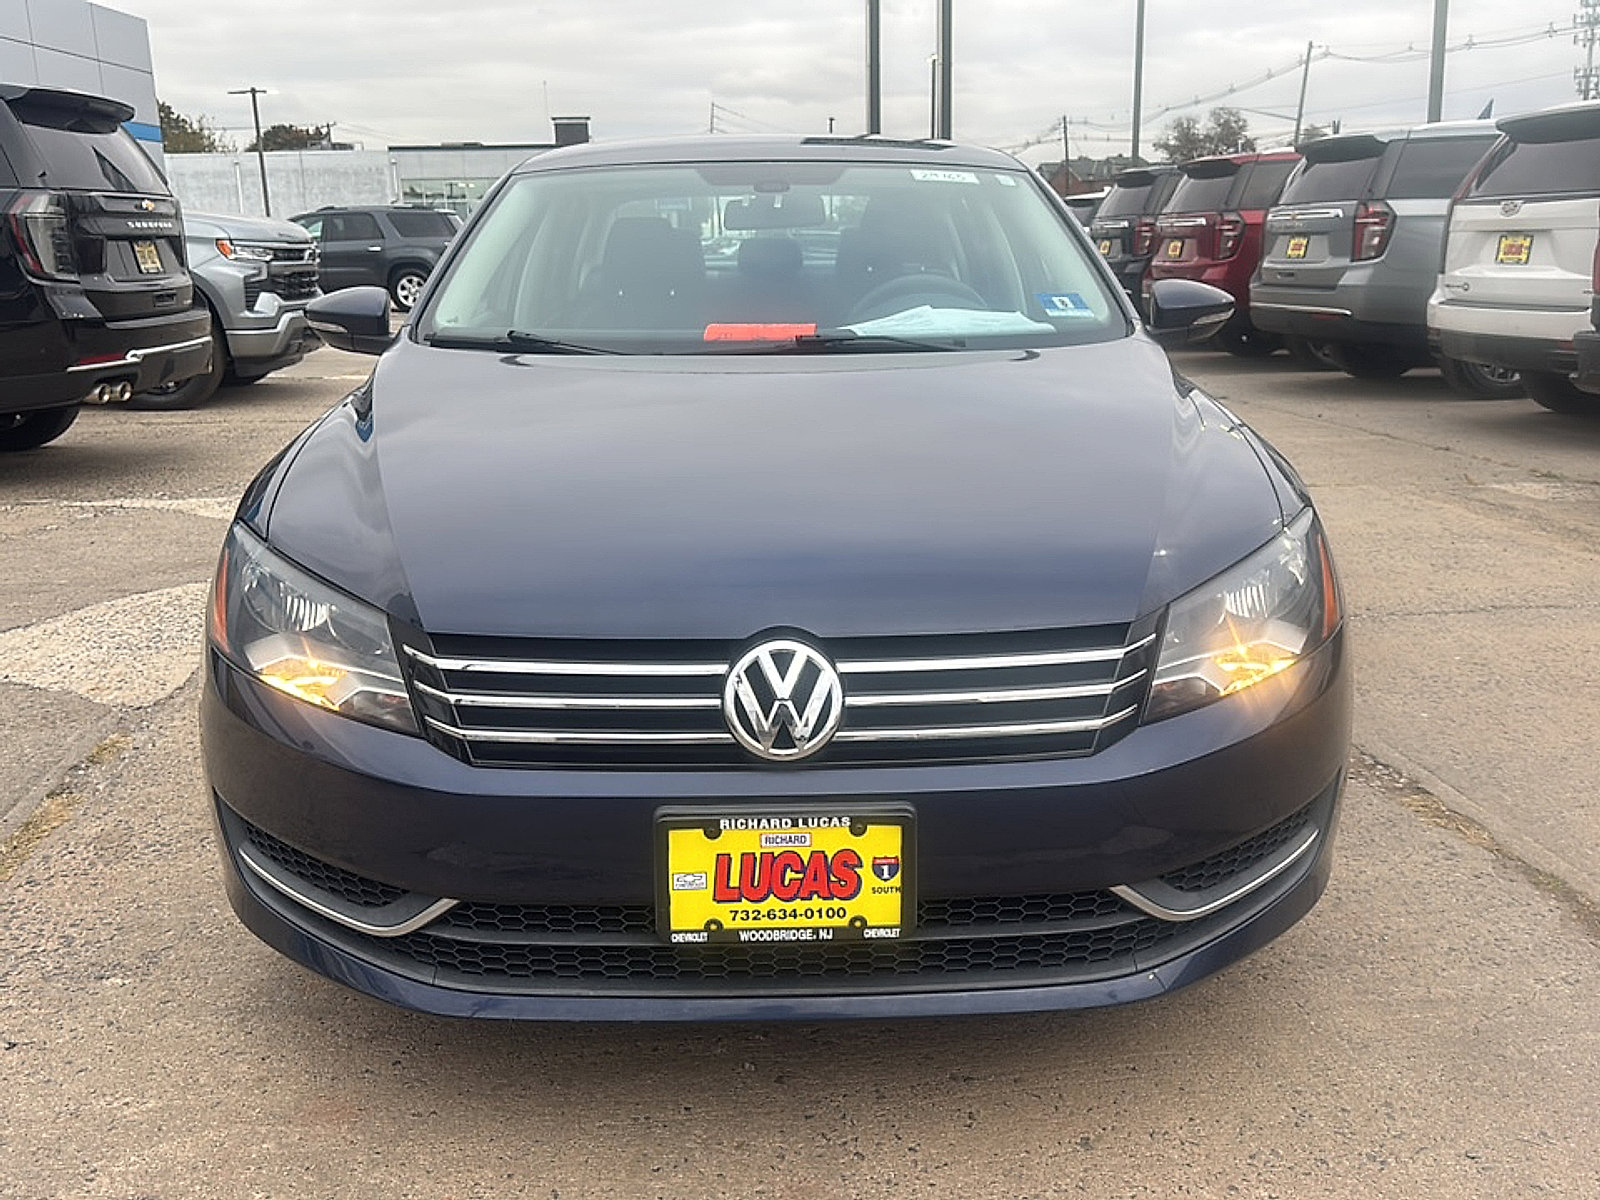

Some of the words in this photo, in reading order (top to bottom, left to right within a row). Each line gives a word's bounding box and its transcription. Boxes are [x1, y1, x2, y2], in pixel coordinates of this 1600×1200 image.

[720, 818, 792, 830] RICHARD
[798, 816, 852, 828] LUCAS
[764, 835, 808, 846] RICHARD
[713, 849, 864, 903] LUCAS
[881, 864, 890, 880] 1
[871, 886, 902, 895] SOUTH
[729, 907, 847, 921] 732-634-0100
[818, 928, 833, 940] NJ
